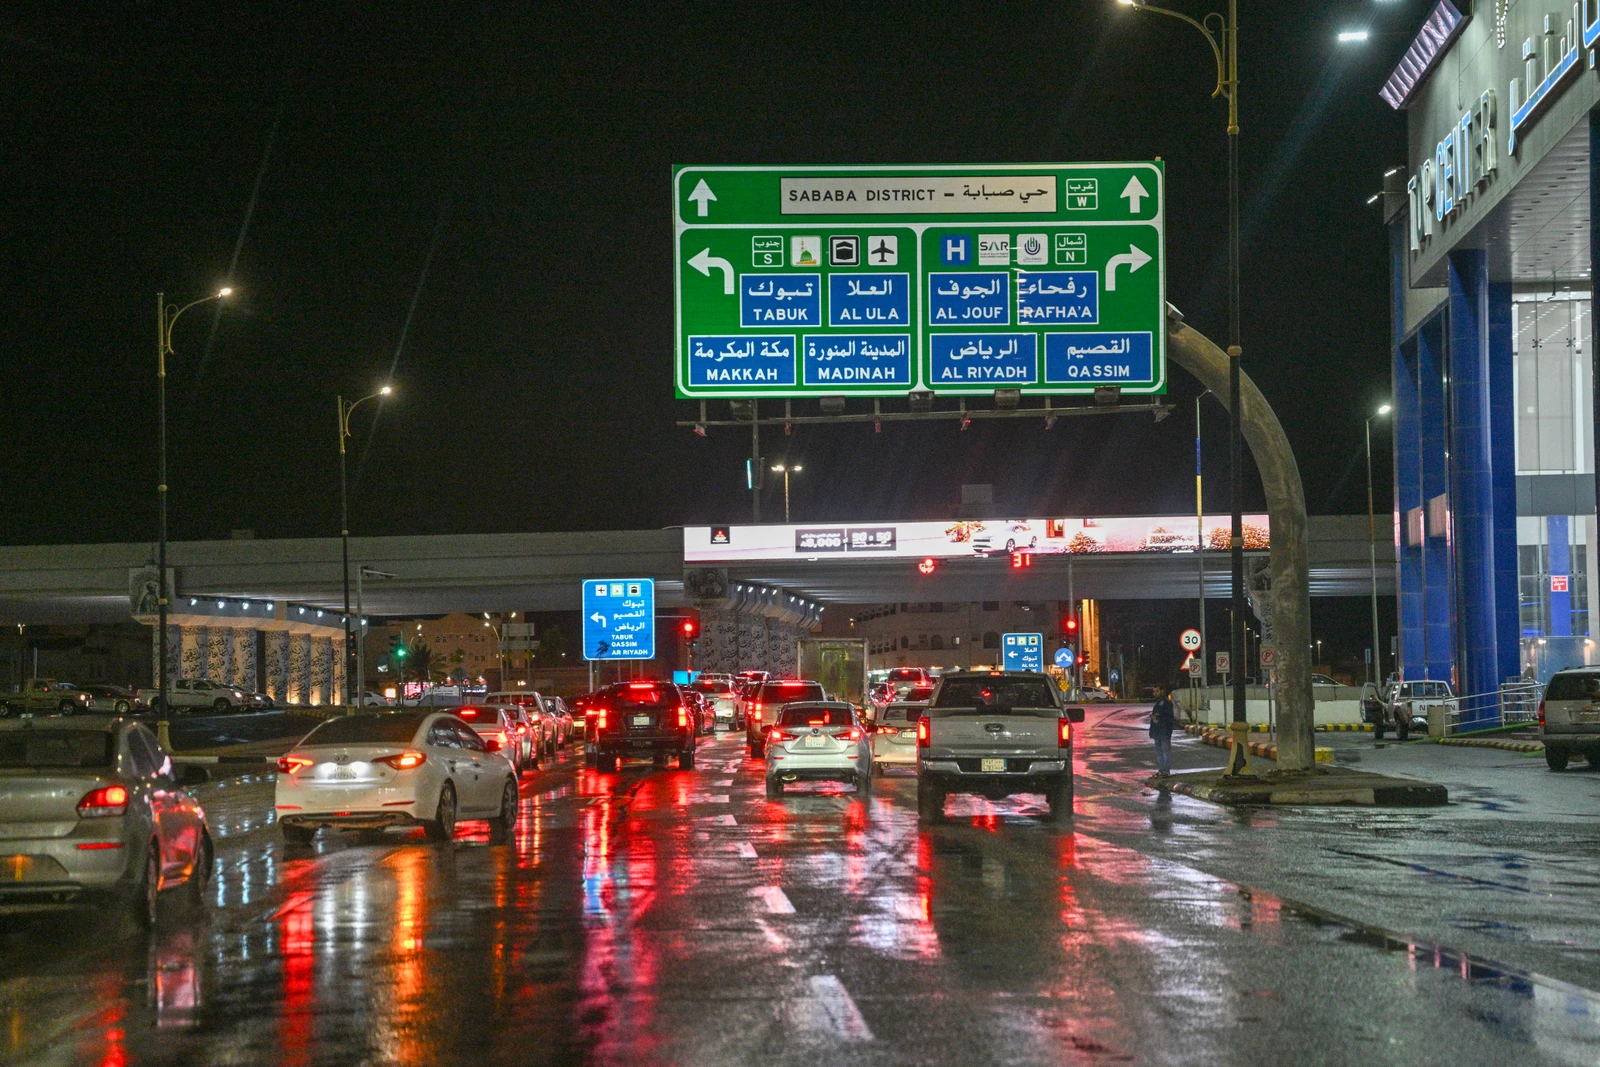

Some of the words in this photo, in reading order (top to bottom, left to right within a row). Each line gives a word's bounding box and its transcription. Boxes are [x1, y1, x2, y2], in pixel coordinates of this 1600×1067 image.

[1408, 158, 1434, 251] TOP
[1435, 89, 1497, 222] CENTER
[962, 184, 1015, 201] صبابة
[1069, 181, 1095, 191] غرب
[789, 189, 857, 202] SABABA
[866, 188, 936, 201] DISTRICT
[1019, 188, 1048, 204] حي
[1077, 196, 1087, 207] W
[754, 240, 780, 249] جنوب
[1058, 235, 1084, 247] شمال
[946, 239, 965, 261] H
[1065, 251, 1075, 262] N
[763, 254, 773, 264] S
[748, 281, 813, 301] تبوك
[846, 279, 893, 296] العلا
[937, 279, 1001, 299] الجوف
[1028, 276, 1088, 298] رفحاء
[753, 308, 808, 321] TABUK
[840, 308, 862, 320] AL
[865, 307, 899, 320] ULA
[935, 308, 958, 319] AL
[961, 307, 1004, 319] JOUF
[1023, 306, 1093, 319] RAFHA'A
[694, 340, 755, 361] المكرمة
[759, 340, 790, 357] مكة
[808, 340, 856, 361] المنورة
[859, 340, 905, 361] المدينة
[949, 339, 1018, 360] الرياض
[1066, 338, 1131, 360] القصيم
[706, 368, 778, 381] MAKKAH
[818, 367, 896, 380] MADINAH
[941, 367, 963, 379] AL
[967, 366, 1027, 379] RIYADH
[1067, 365, 1130, 378] QASSIM
[1013, 553, 1030, 567] 31
[622, 599, 645, 609] تبوك
[613, 609, 645, 620] القصيم
[614, 621, 645, 632] الرياض
[1184, 636, 1198, 644] 30
